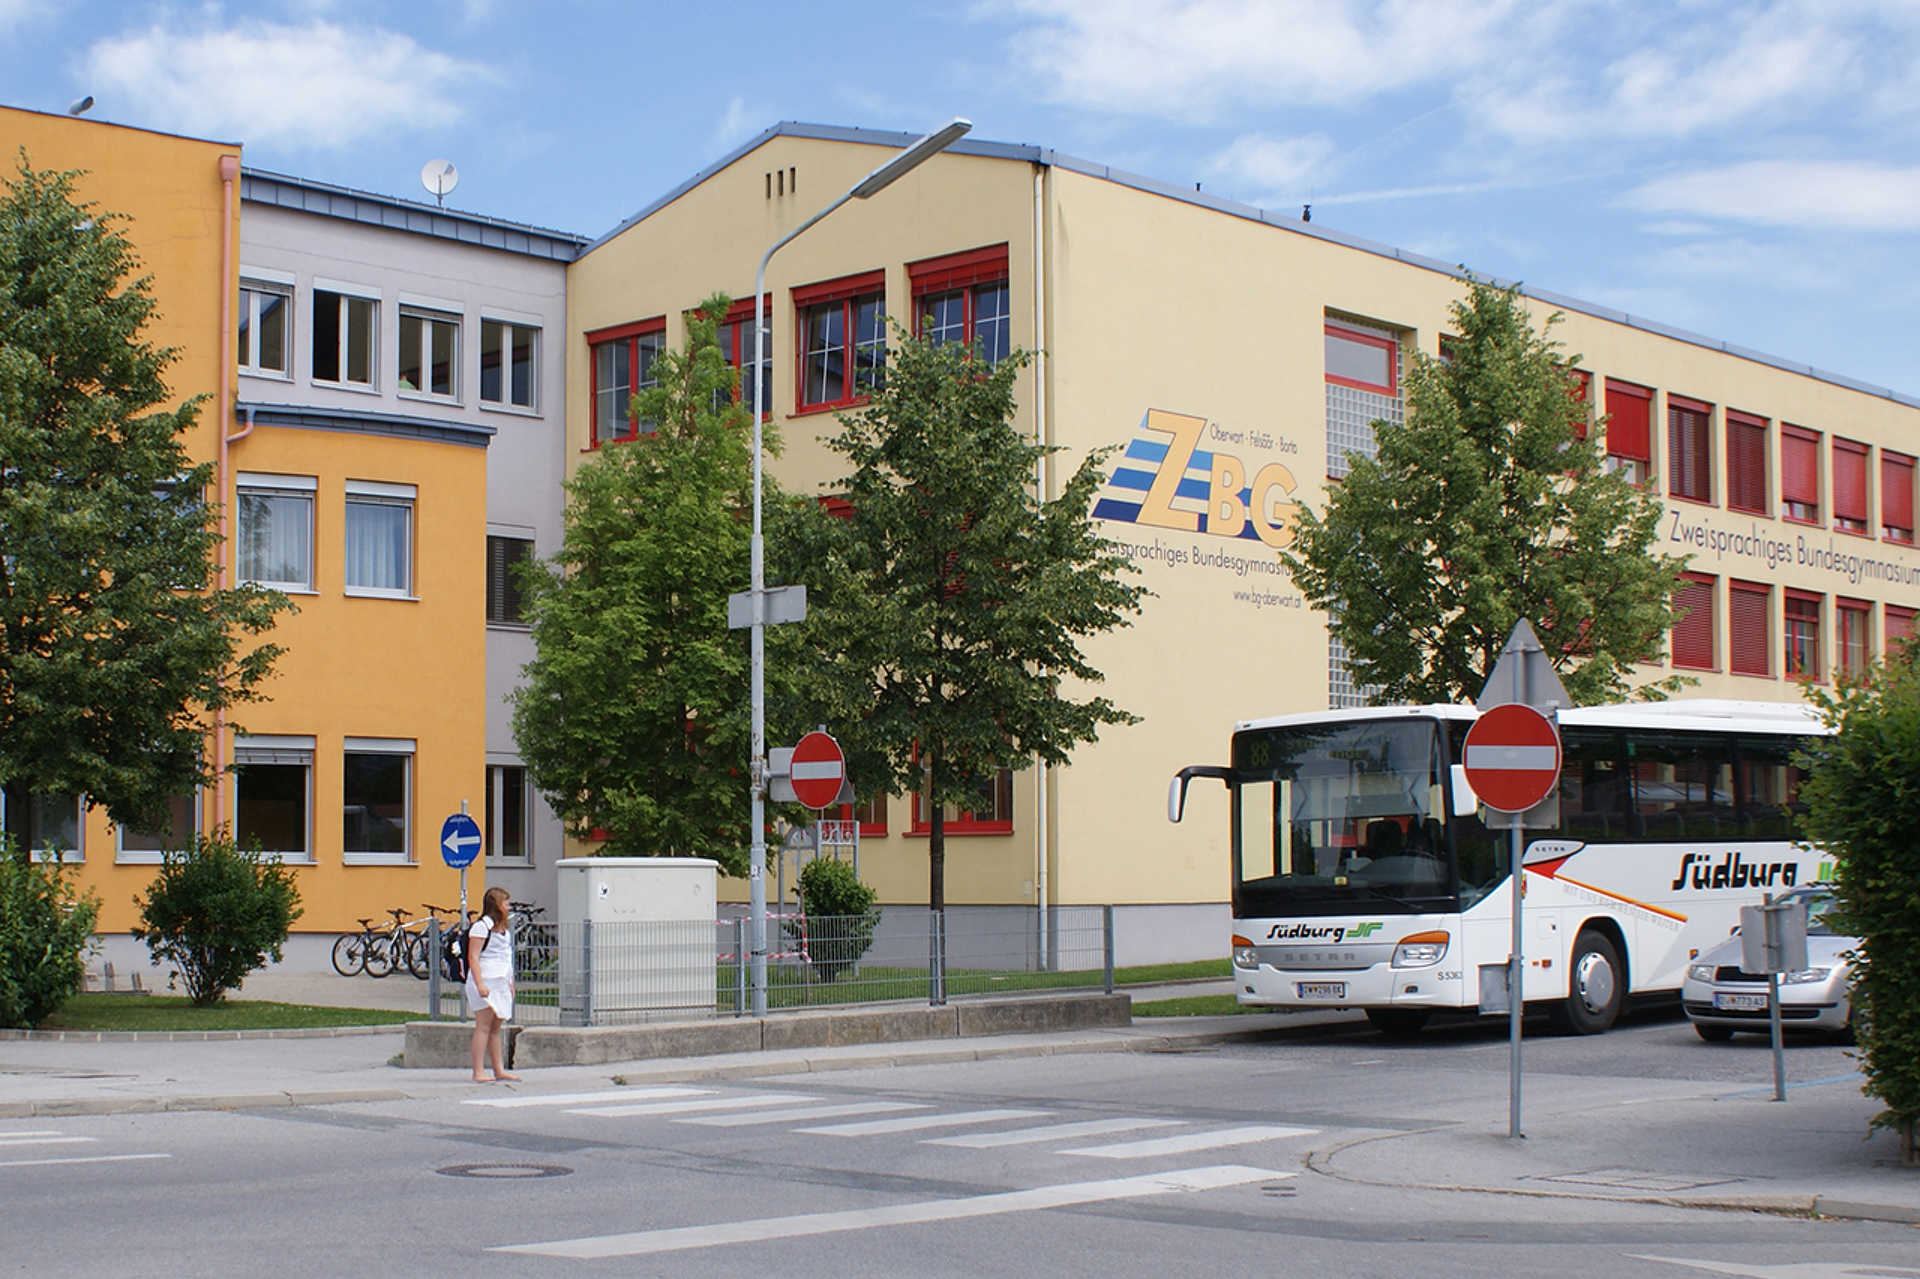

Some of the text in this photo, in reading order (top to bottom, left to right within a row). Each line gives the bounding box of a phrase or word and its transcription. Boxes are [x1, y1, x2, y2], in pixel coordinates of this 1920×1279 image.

[1210, 422, 1244, 444] Oberwart
[1136, 408, 1298, 549] ZBG
[1670, 510, 1792, 569] Zweisprachiges
[1192, 545, 1291, 578] Bundesgymnasiu
[1671, 851, 1799, 891] Südburg
[1266, 923, 1346, 943] Südburg
[1284, 952, 1356, 961] SETRA
